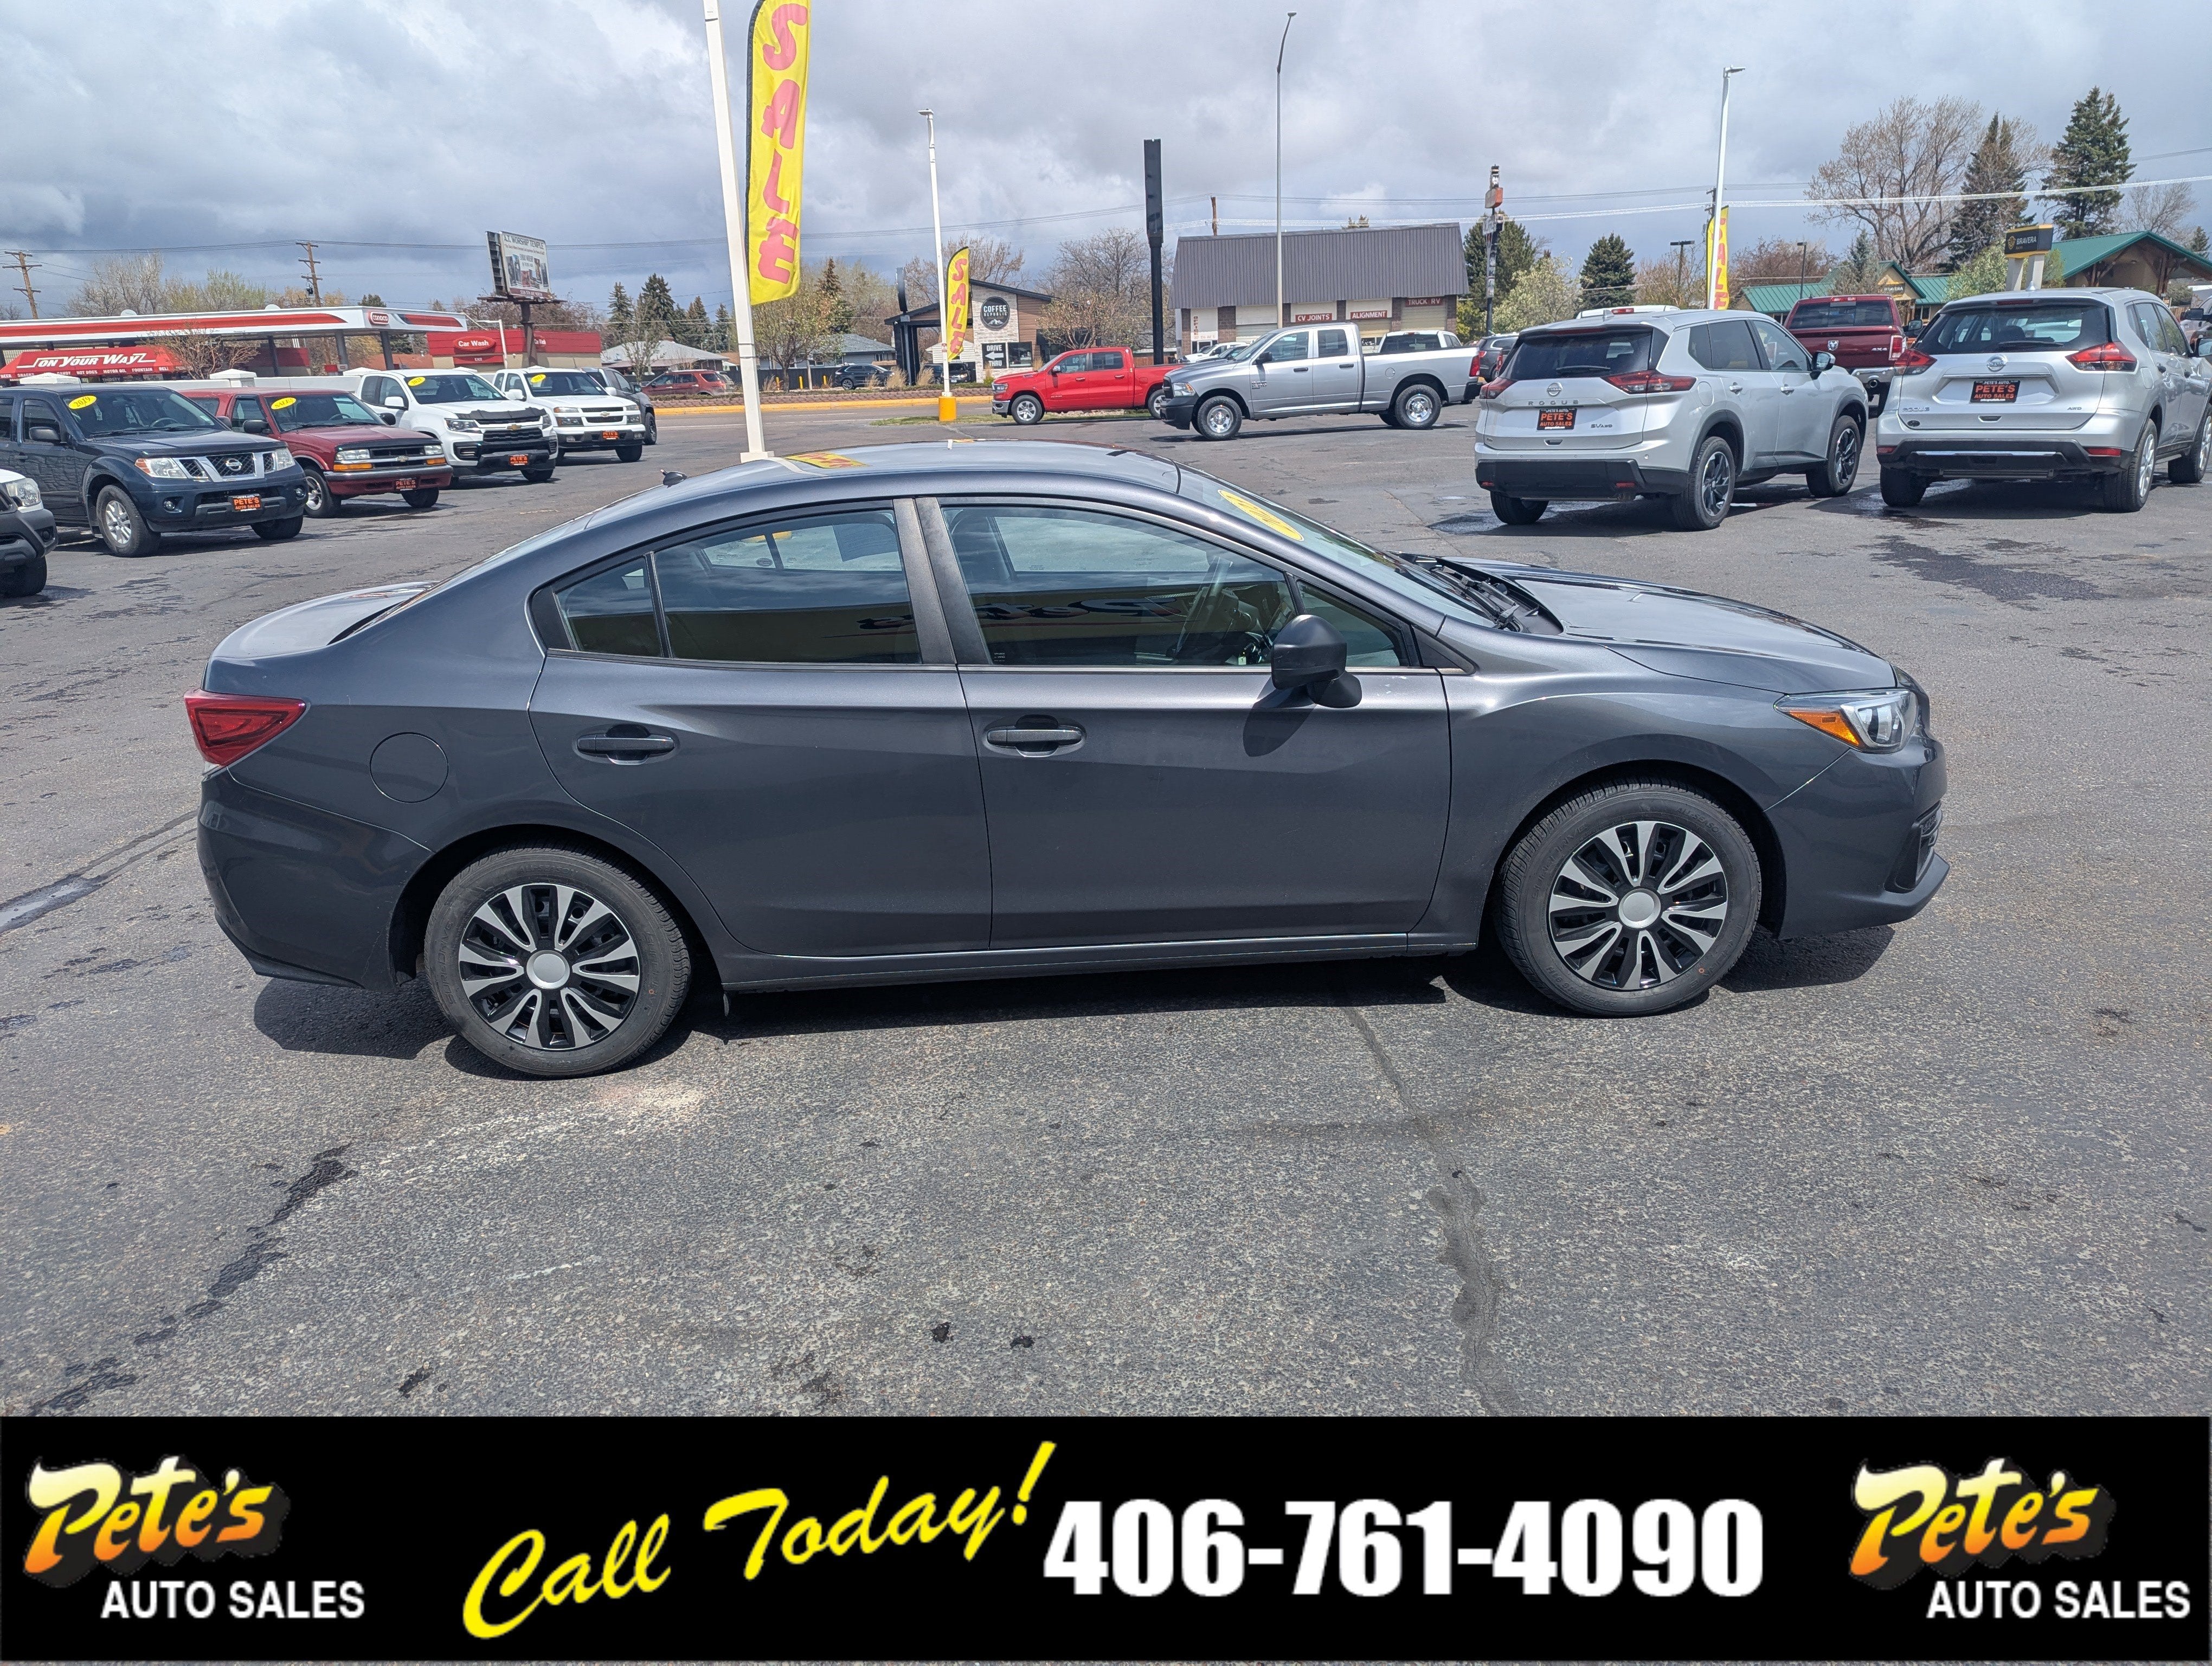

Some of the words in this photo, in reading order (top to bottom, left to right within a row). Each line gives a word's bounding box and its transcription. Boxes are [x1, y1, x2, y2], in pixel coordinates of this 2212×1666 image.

[758, 3, 808, 285] SALE
[2017, 236, 2037, 245] BRAVERA
[950, 258, 968, 354] SALE
[38, 359, 59, 367] ON
[59, 356, 99, 368] YOUR
[1975, 385, 2016, 393] PETE'S
[73, 396, 91, 407] 2019
[1541, 412, 1573, 421] PETE'S
[233, 497, 260, 505] PETE'S
